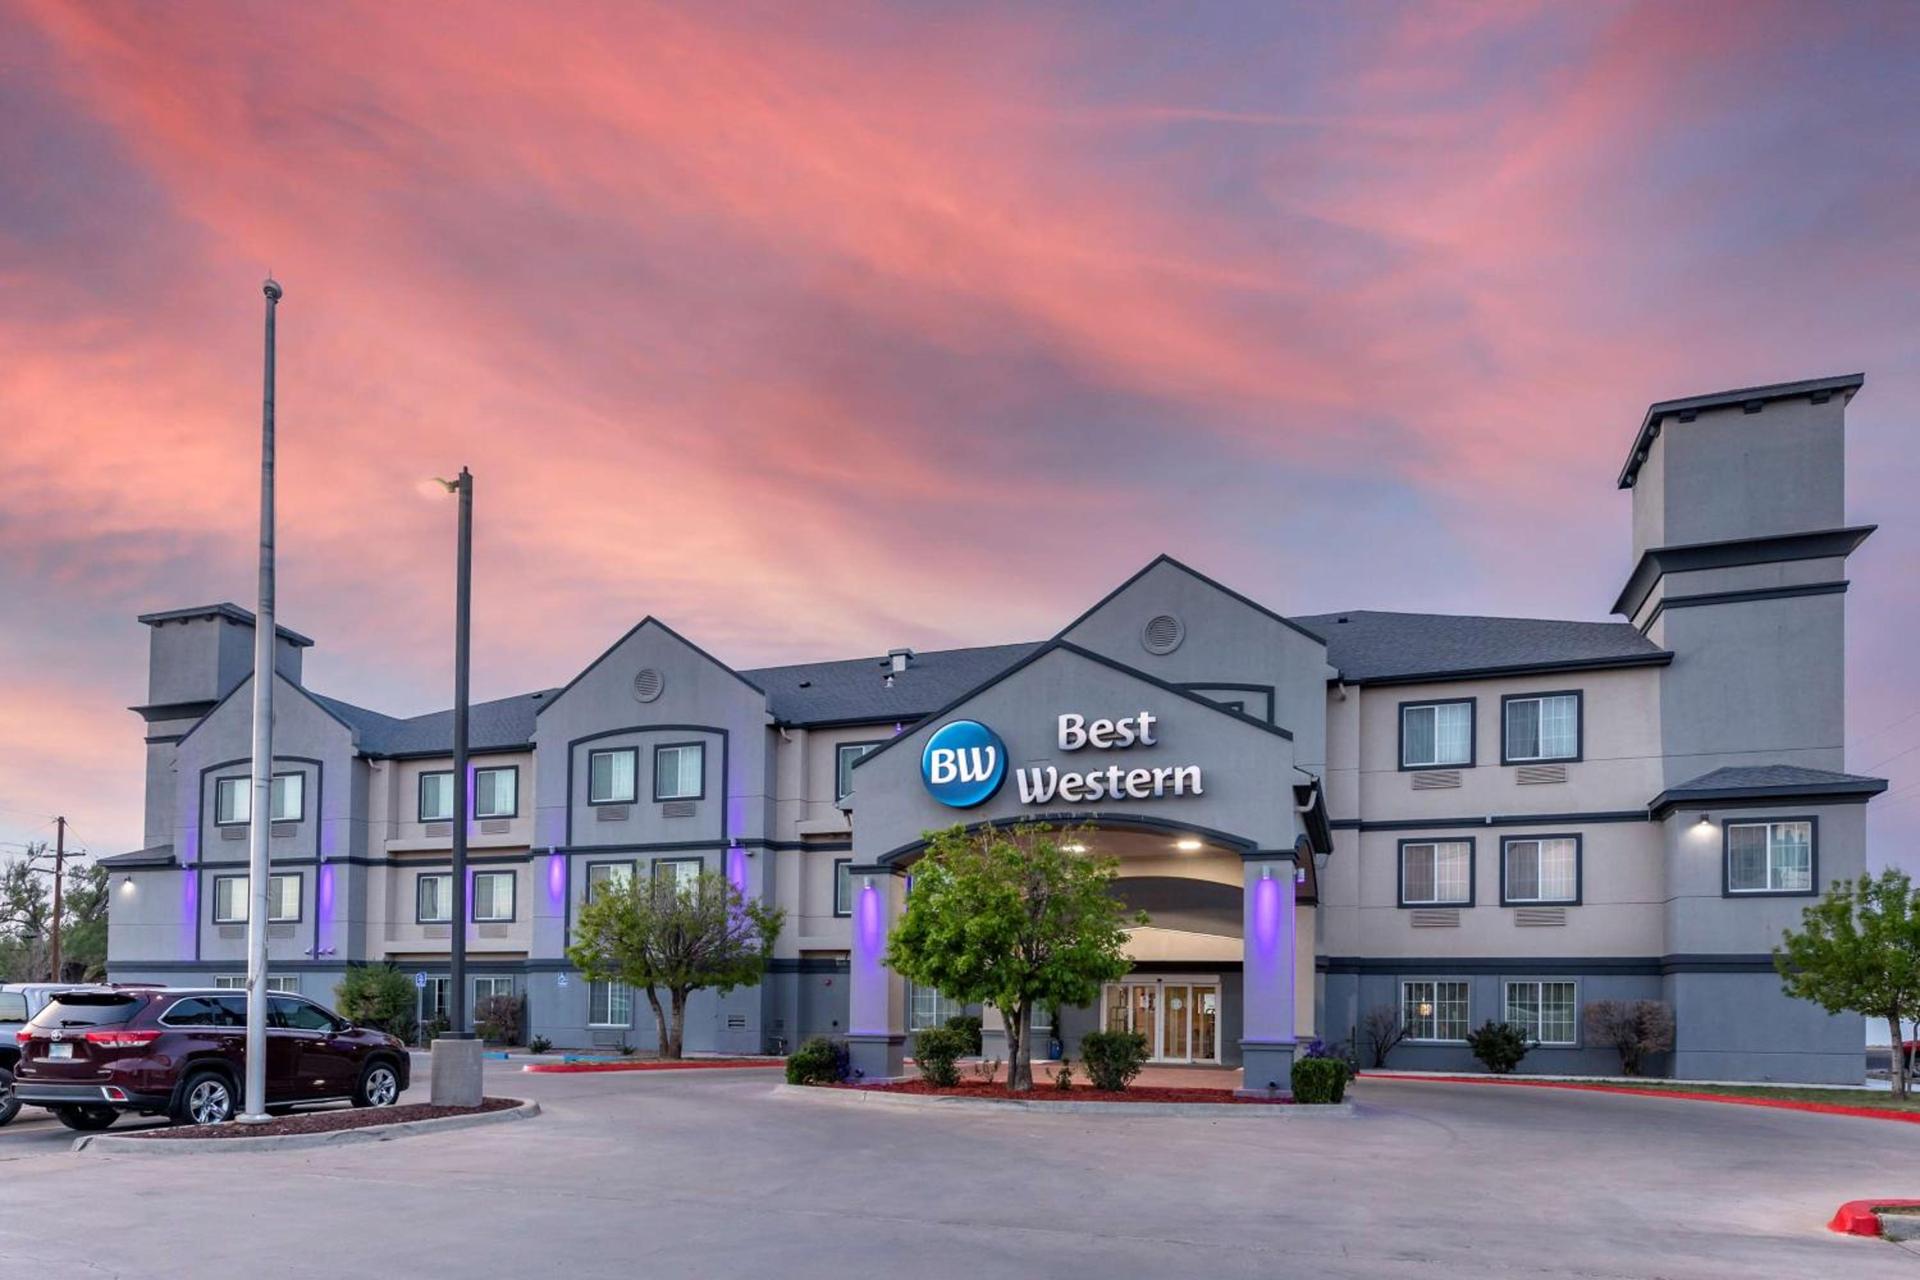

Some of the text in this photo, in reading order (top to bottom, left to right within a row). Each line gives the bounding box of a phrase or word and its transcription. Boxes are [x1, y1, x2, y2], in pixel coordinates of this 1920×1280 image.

[1057, 711, 1158, 750] Best
[931, 746, 996, 784] BW
[1016, 765, 1203, 804] Western
